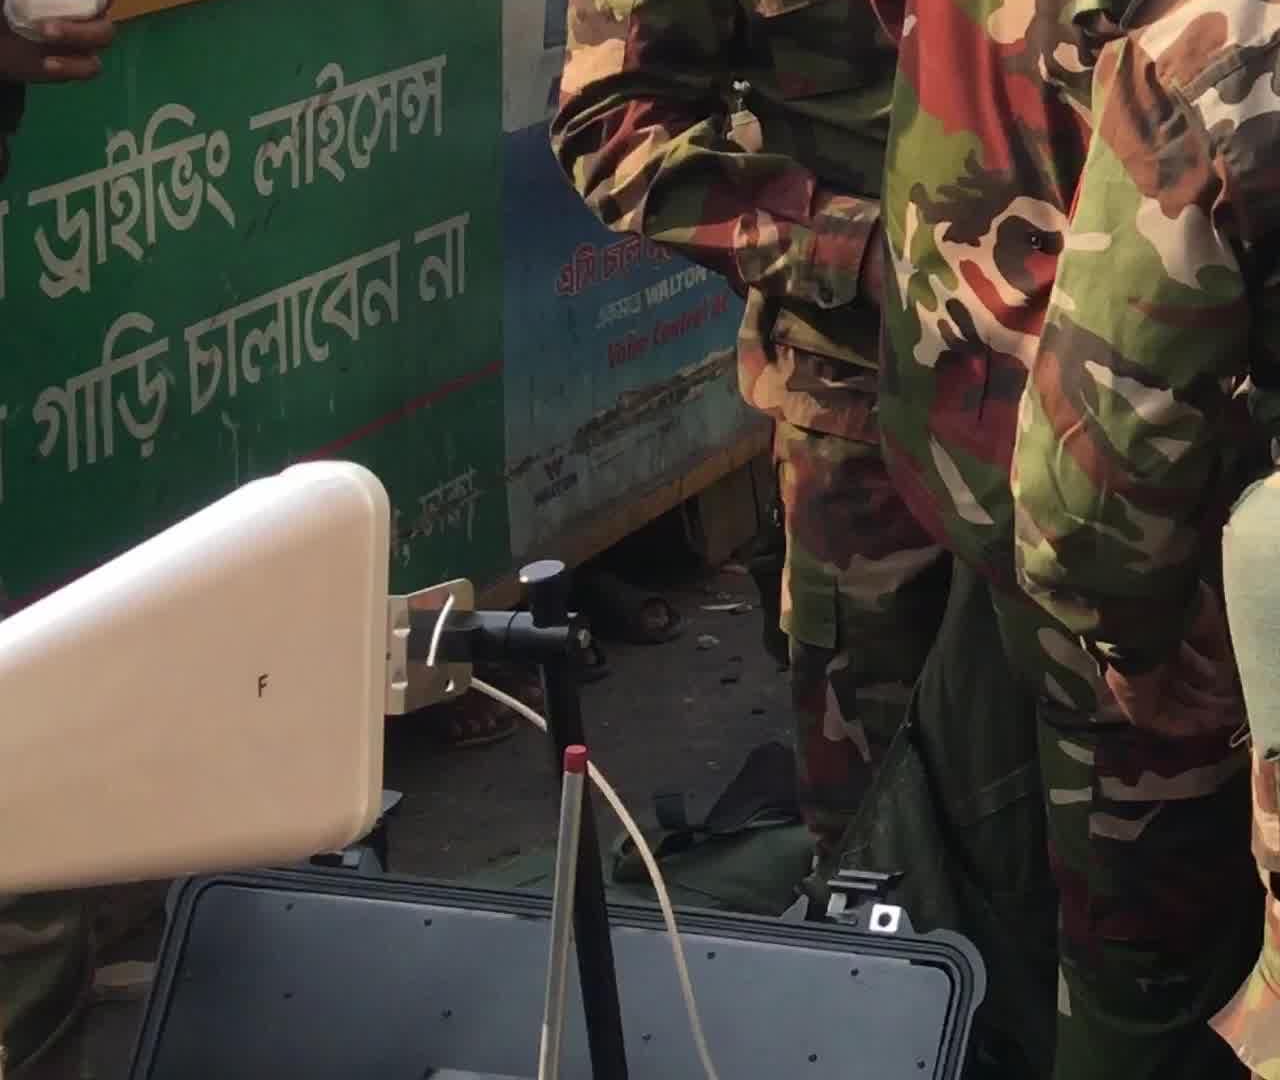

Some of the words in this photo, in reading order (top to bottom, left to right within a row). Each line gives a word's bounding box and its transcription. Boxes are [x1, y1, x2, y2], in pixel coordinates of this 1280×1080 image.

[28, 103, 236, 300] ড্রাইভিং
[249, 53, 448, 199] লাইসেন্স
[33, 311, 171, 474] গাড়ি
[185, 238, 400, 415] চালাবেন
[415, 213, 471, 304] না
[258, 674, 268, 699] F
